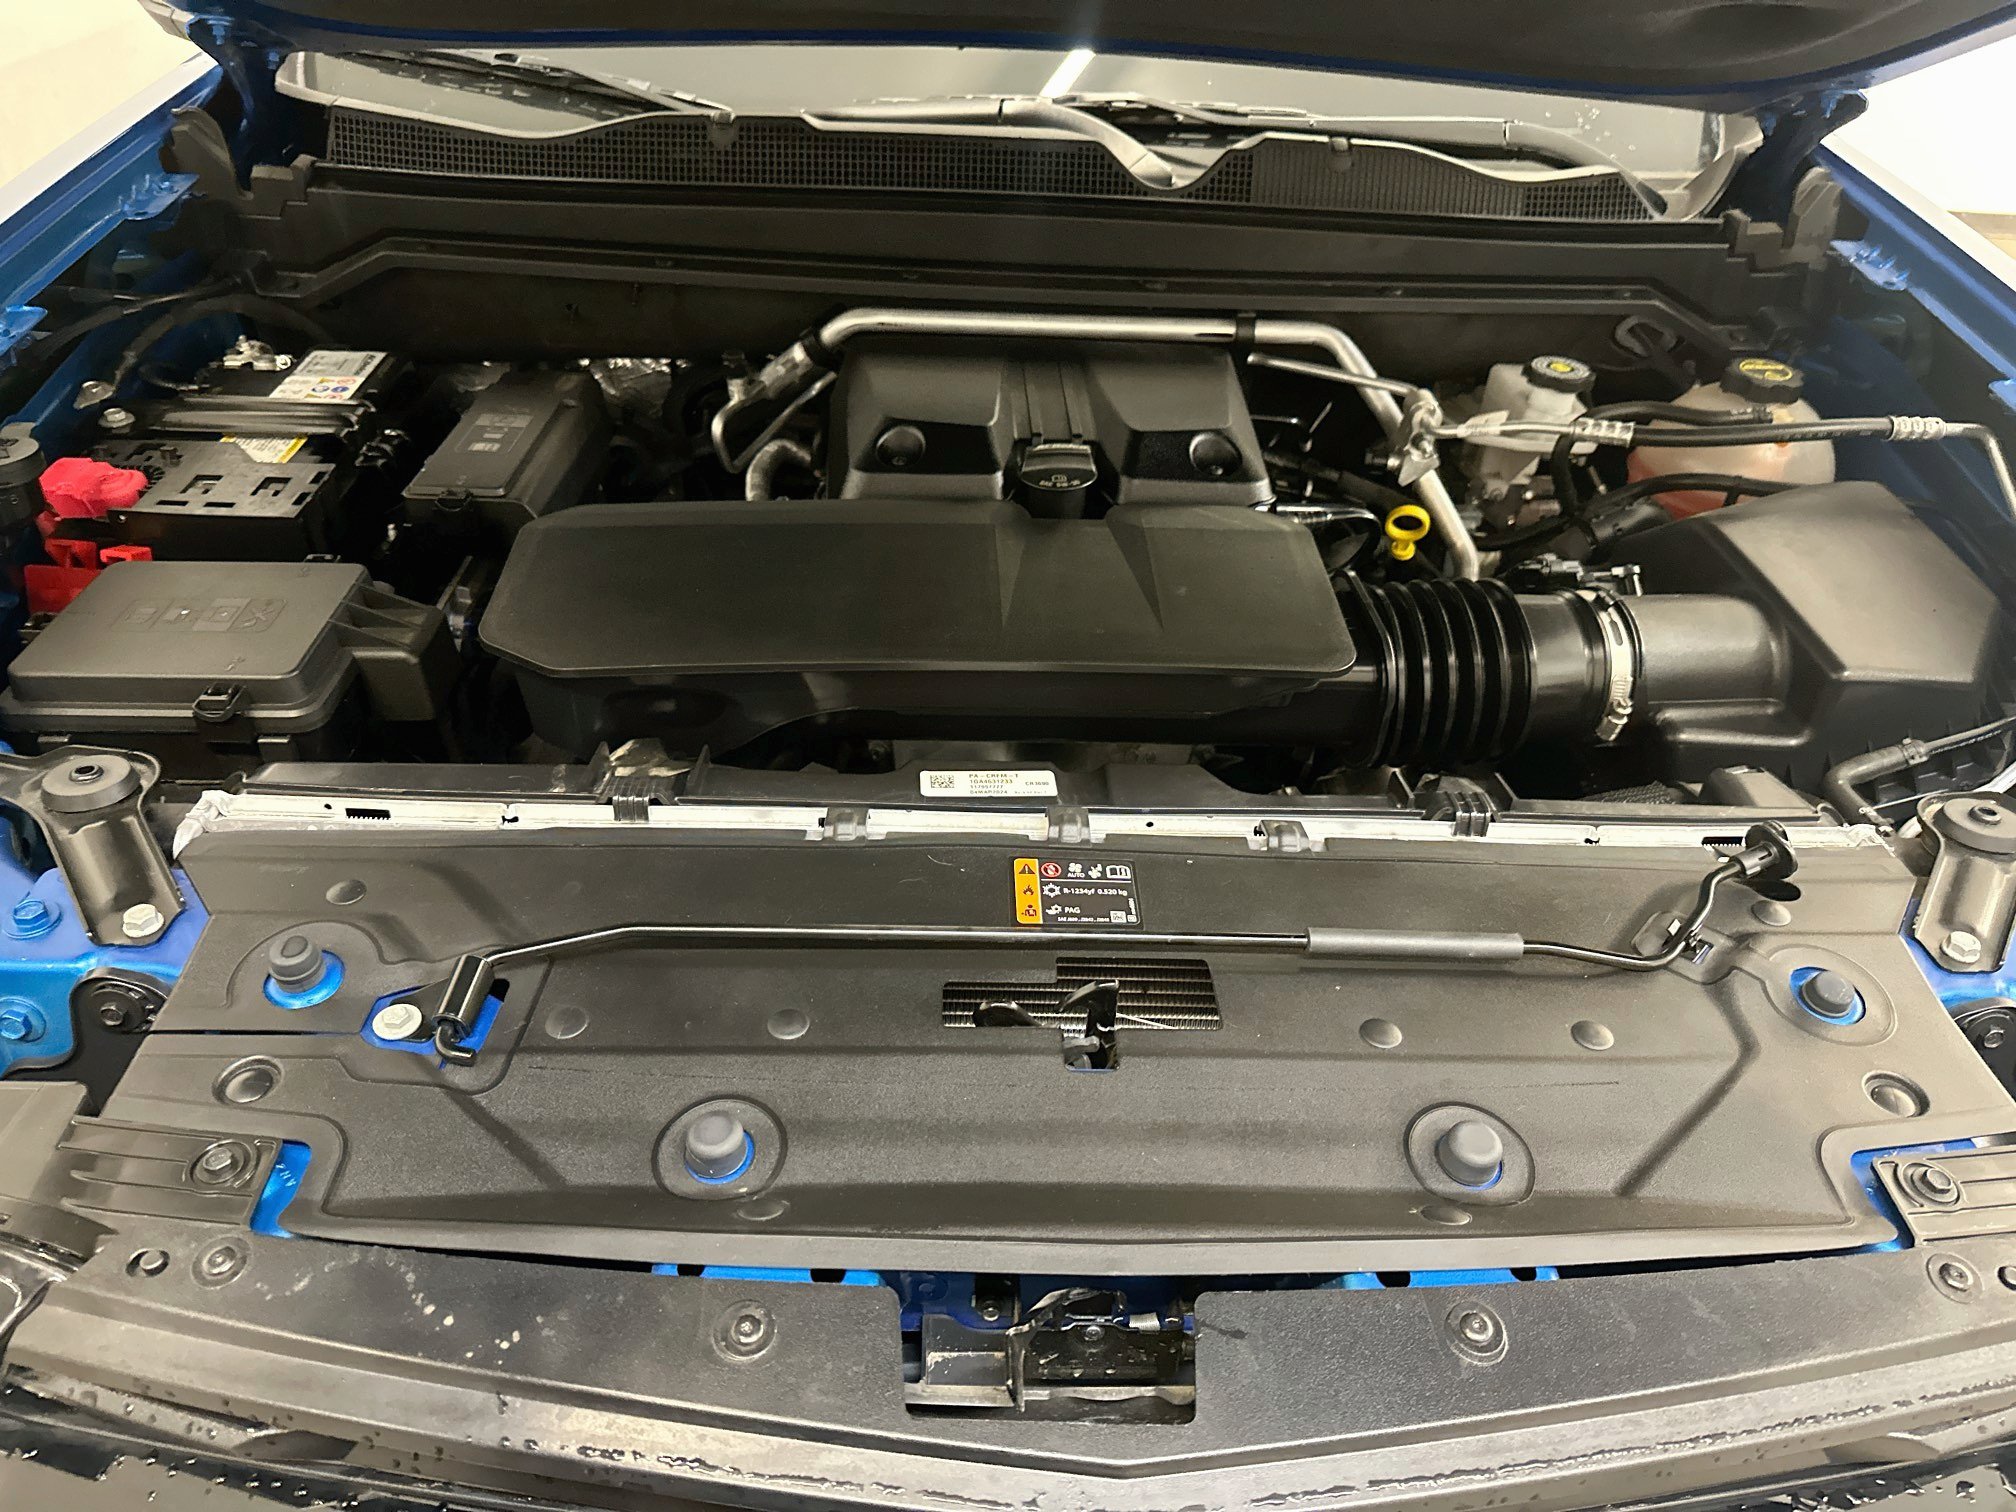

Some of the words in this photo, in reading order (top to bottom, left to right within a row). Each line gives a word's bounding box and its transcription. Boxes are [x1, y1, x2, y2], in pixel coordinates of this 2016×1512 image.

[1063, 887, 1095, 896] R-1234yf
[1097, 888, 1117, 896] 0.520
[1118, 889, 1128, 897] kg
[1064, 906, 1081, 914] PAG
